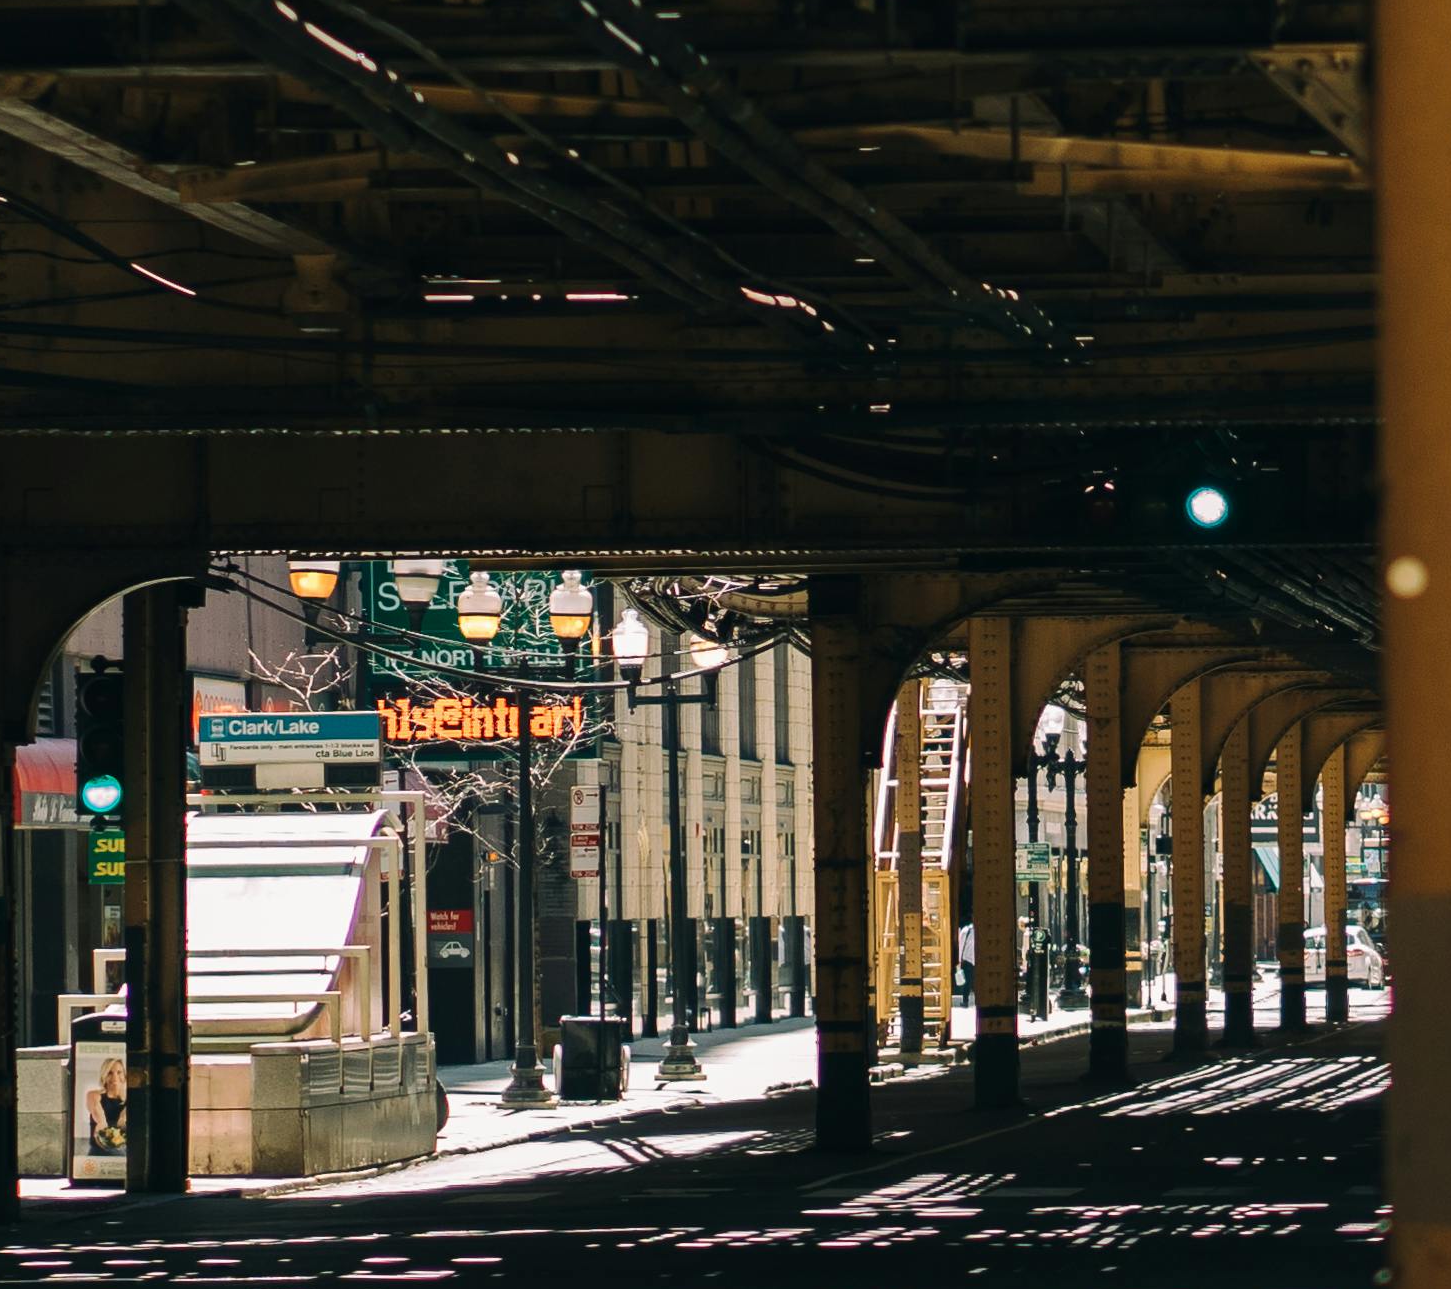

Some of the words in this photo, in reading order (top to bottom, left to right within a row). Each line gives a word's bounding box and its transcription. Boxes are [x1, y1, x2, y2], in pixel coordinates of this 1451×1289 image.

[228, 719, 320, 736] Clark/Lake
[316, 749, 331, 758] cta
[332, 749, 353, 758] Blue
[355, 748, 375, 757] Line
[430, 911, 449, 921] Watch
